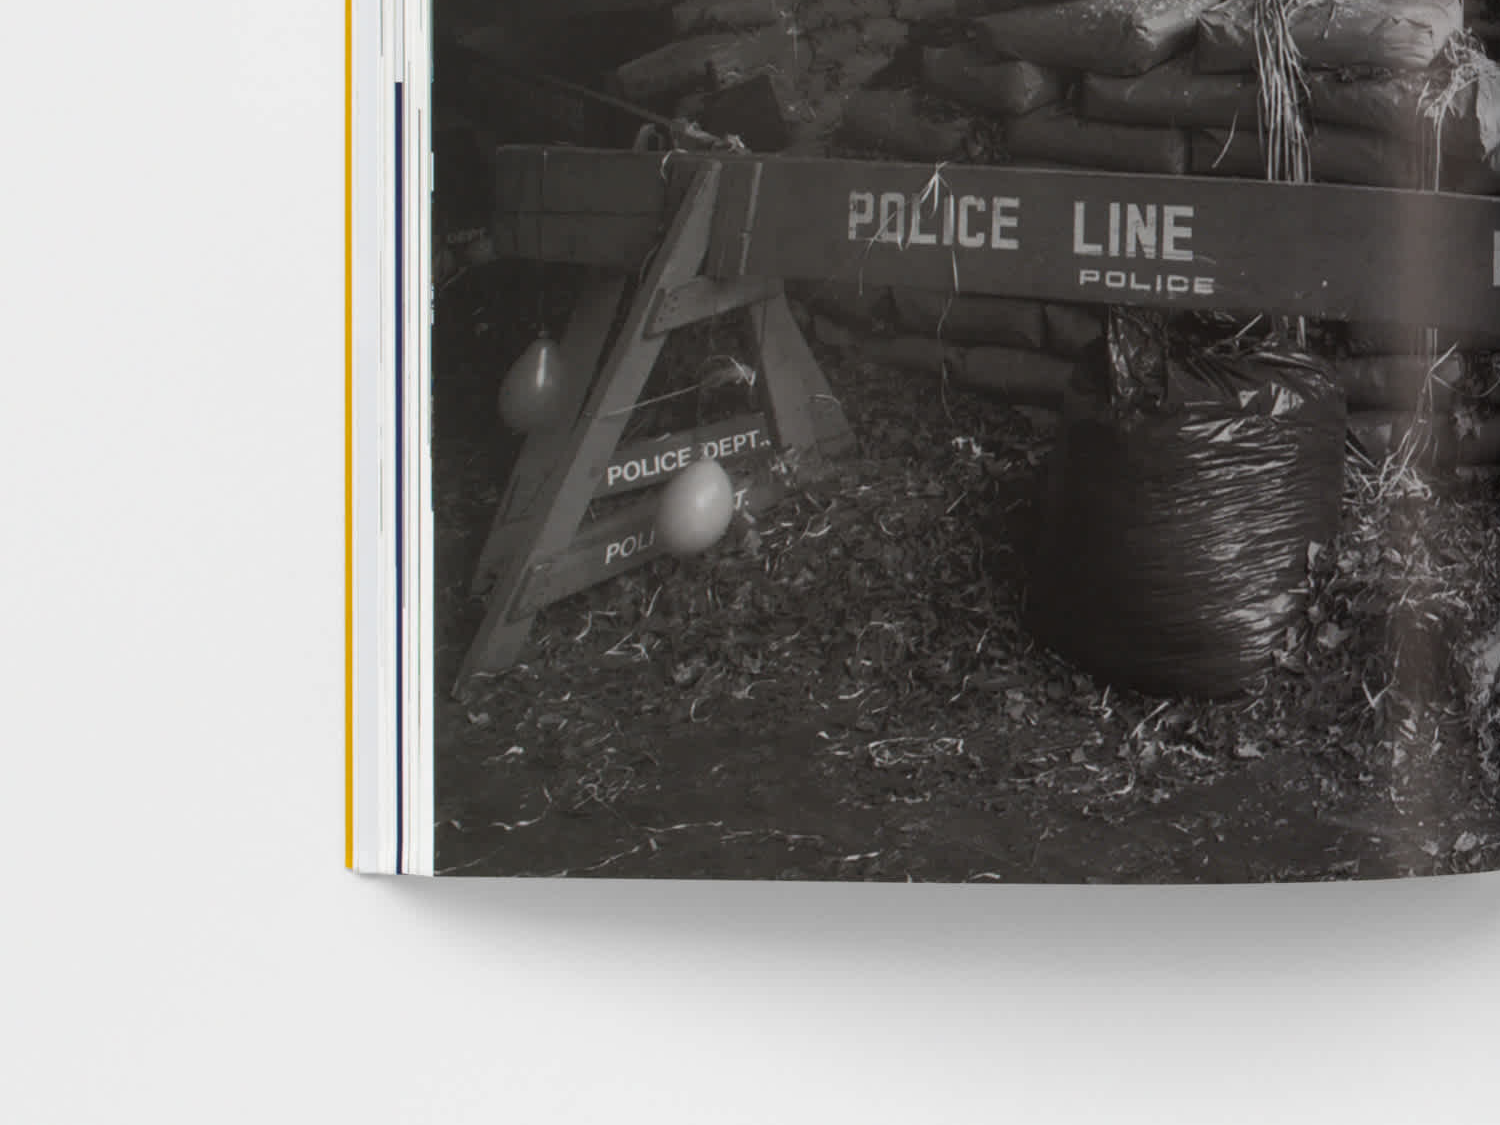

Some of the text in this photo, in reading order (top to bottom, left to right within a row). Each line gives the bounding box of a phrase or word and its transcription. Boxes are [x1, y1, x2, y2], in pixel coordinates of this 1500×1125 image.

[848, 190, 1021, 250] POLICE
[1073, 200, 1194, 262] LINE
[1079, 270, 1215, 295] POLICE
[607, 446, 692, 486] POLICE
[605, 531, 655, 565] POLI
